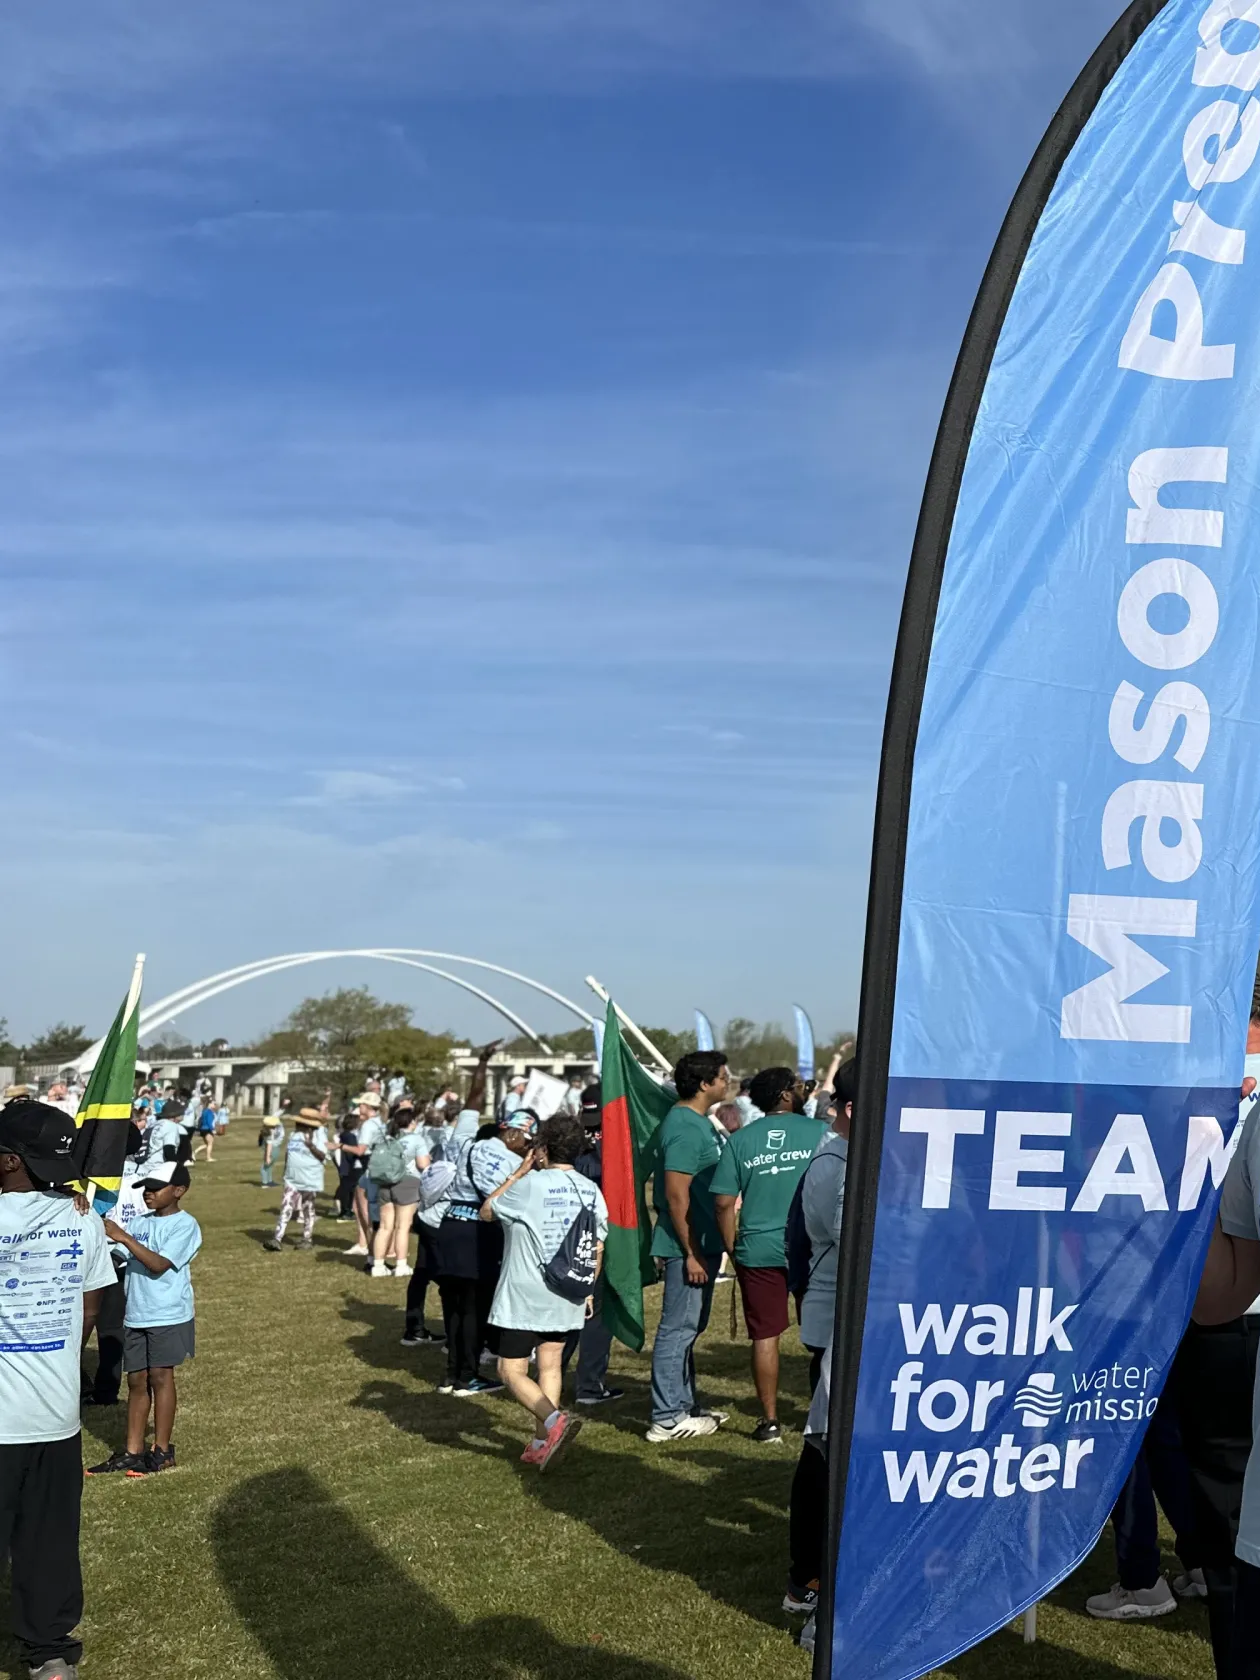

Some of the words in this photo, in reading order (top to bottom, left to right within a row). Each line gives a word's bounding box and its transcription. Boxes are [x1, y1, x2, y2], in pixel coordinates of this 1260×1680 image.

[1059, 446, 1228, 1044] Mason
[744, 1153, 777, 1169] water
[780, 1149, 812, 1162] crew
[47, 1227, 82, 1239] water
[898, 1287, 1080, 1356] walk
[890, 1361, 1004, 1432] for
[1072, 1361, 1154, 1394] water
[1065, 1391, 1159, 1423] missio
[882, 1432, 1096, 1503] water
